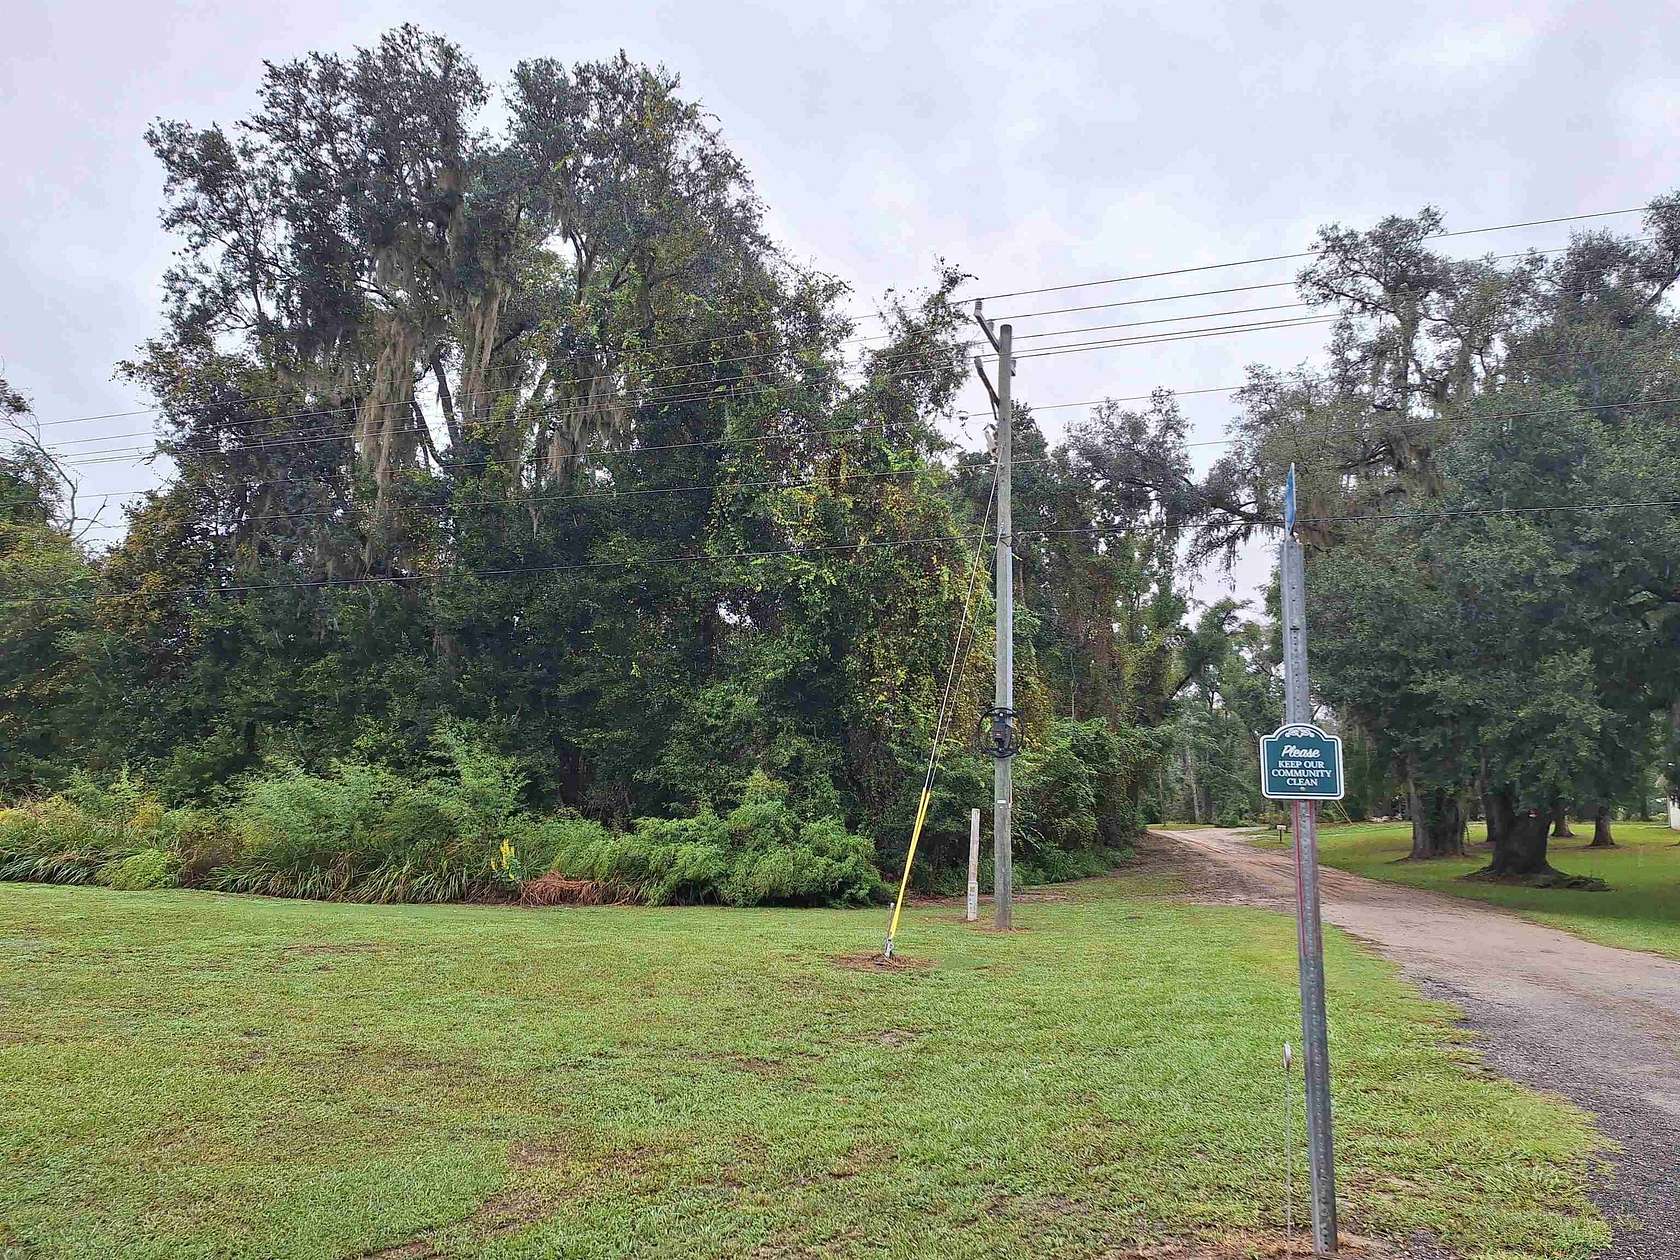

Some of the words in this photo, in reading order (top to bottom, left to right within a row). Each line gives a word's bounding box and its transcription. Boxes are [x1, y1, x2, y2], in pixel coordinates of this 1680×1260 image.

[1281, 744, 1320, 758] Please
[1304, 760, 1324, 768] OUR
[1272, 769, 1332, 777] COMMUNITY
[1286, 778, 1318, 786] CLEAN
